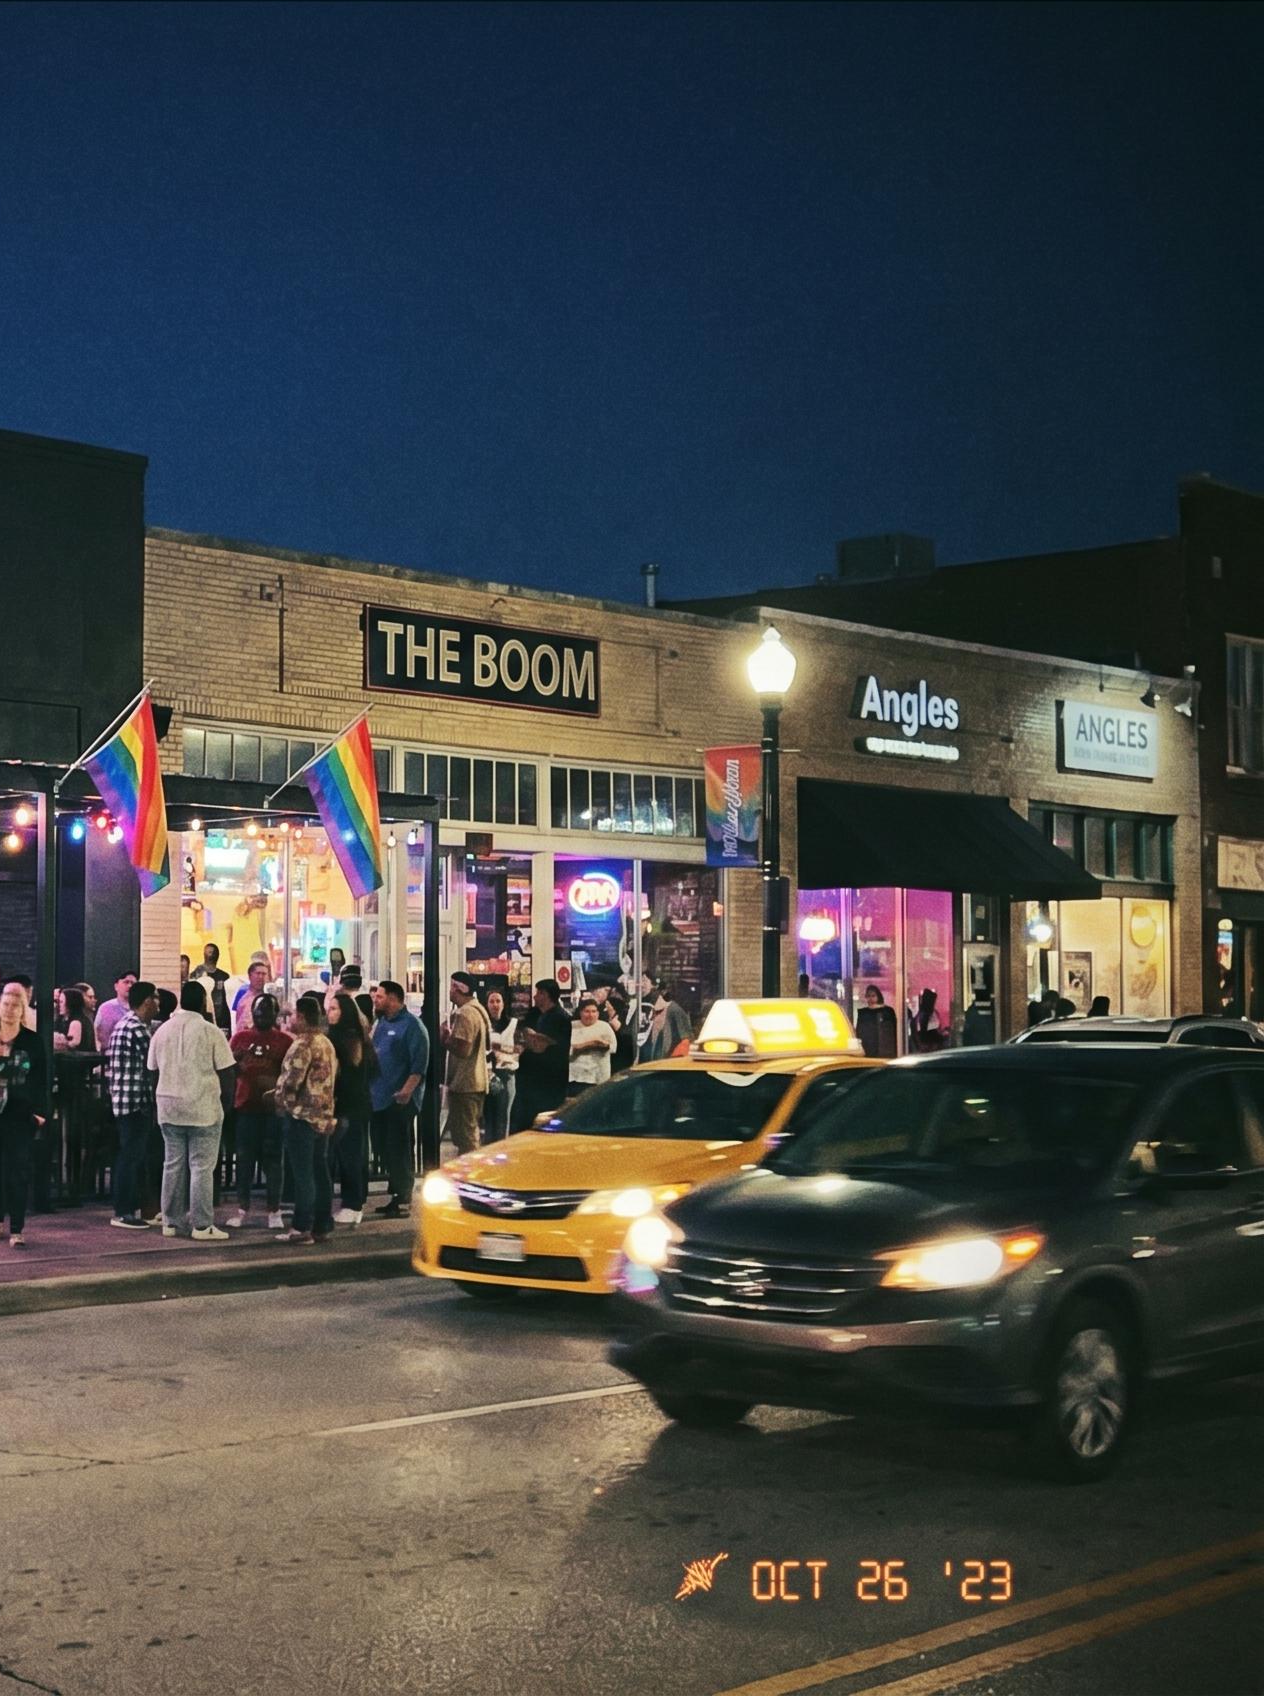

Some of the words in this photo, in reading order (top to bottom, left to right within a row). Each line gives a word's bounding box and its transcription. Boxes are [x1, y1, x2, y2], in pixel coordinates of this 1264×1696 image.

[377, 620, 462, 684] THE
[473, 634, 596, 701] BOOM
[860, 675, 960, 737] Angles
[1075, 713, 1149, 750] ANGLES
